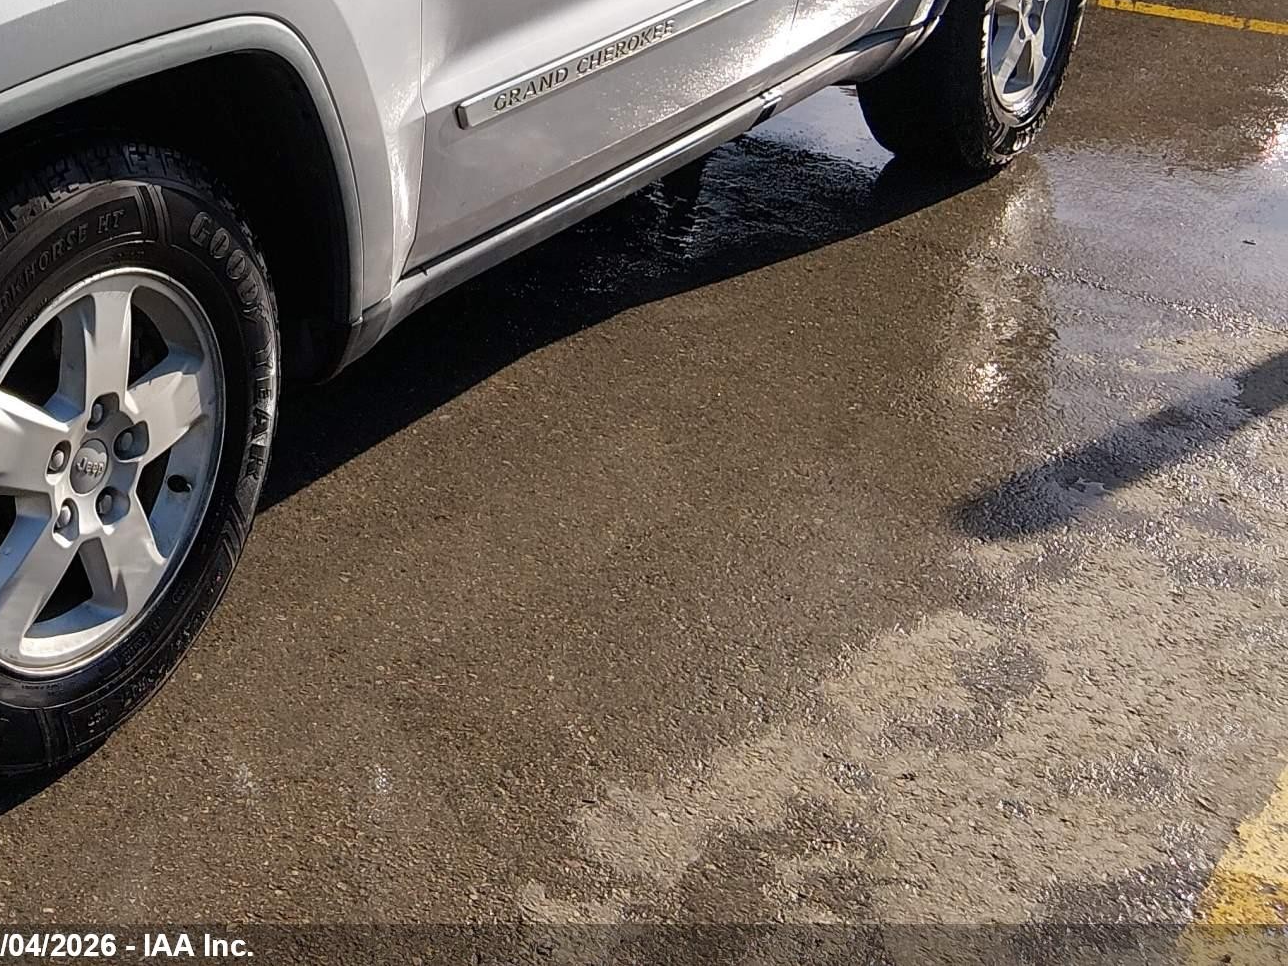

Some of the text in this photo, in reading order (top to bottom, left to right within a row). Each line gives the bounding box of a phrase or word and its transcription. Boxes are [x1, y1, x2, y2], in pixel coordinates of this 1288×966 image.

[493, 18, 676, 112] GRAND CHEROKEE
[76, 456, 105, 478] Jeep
